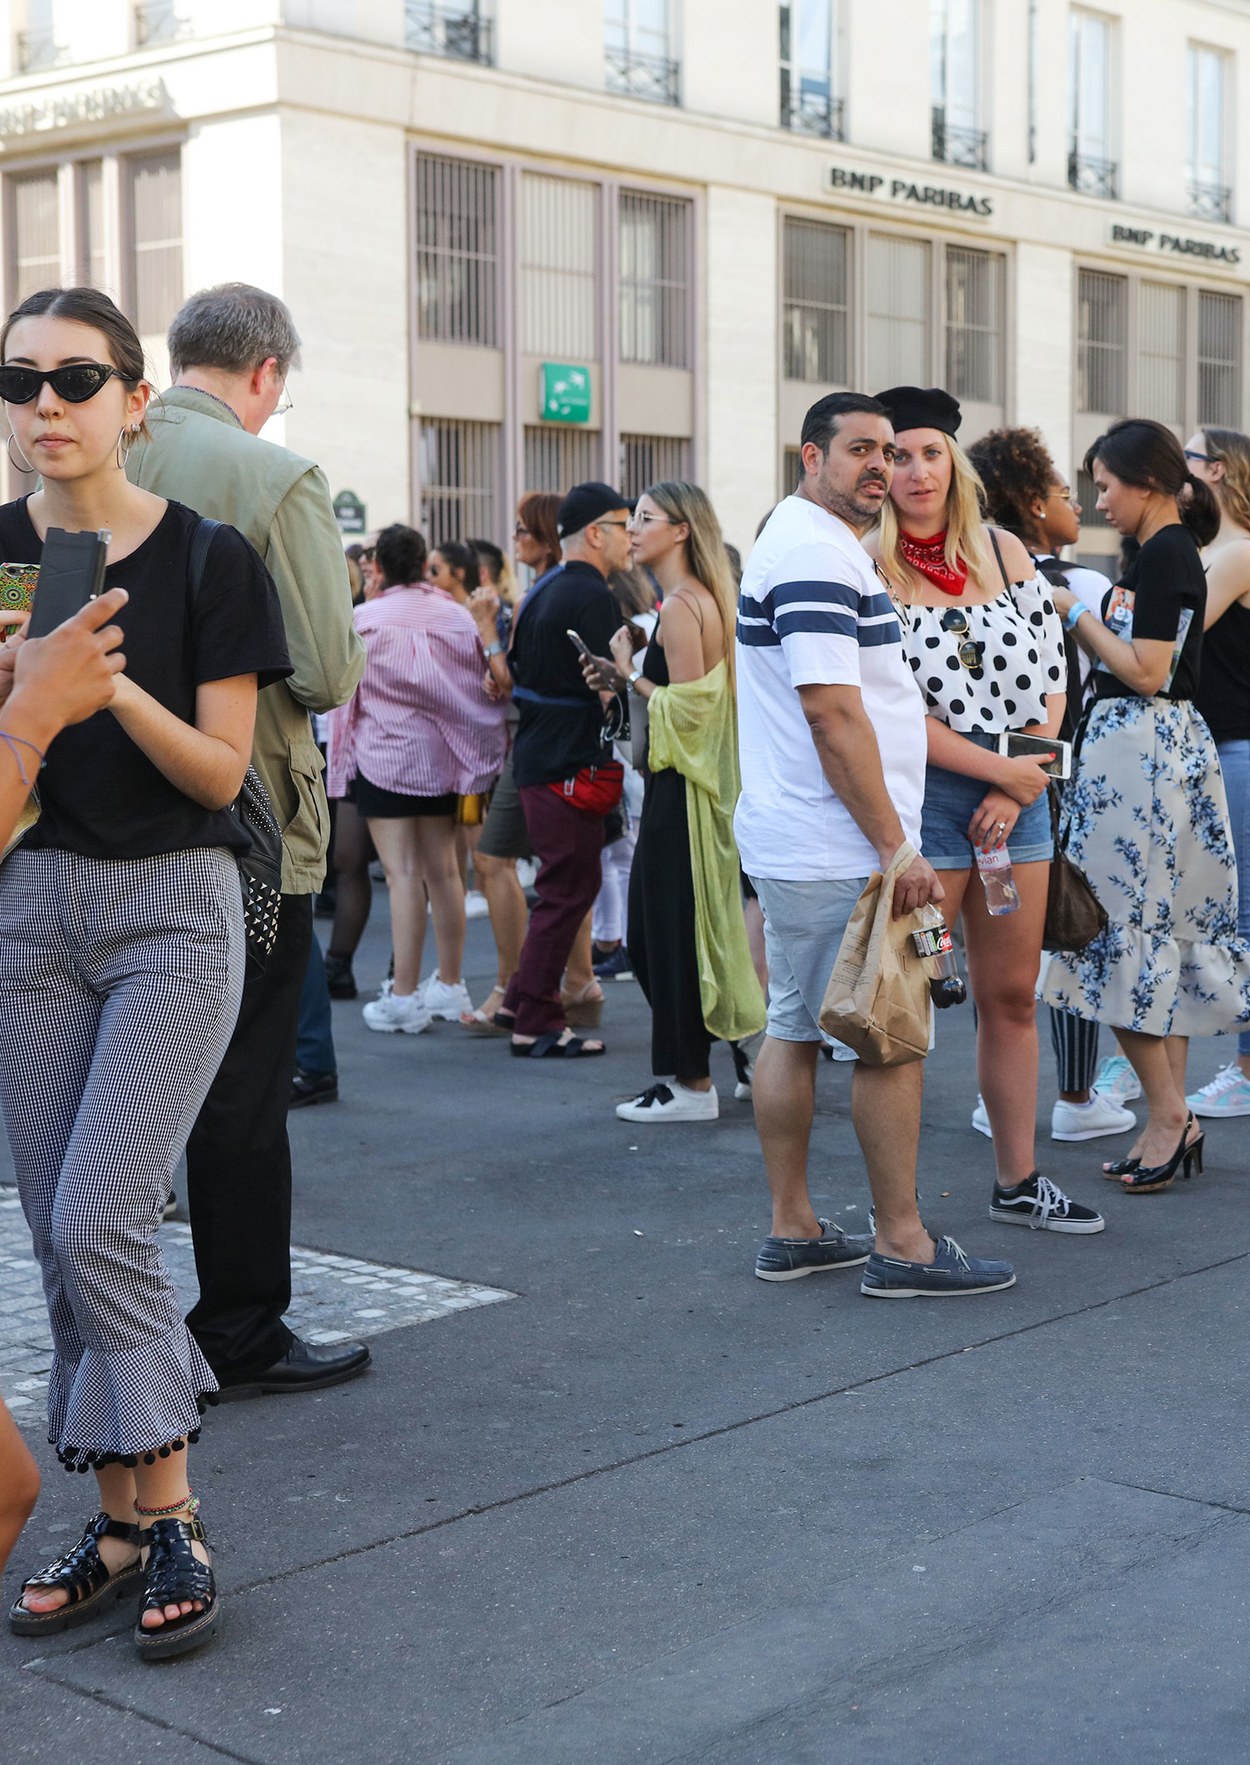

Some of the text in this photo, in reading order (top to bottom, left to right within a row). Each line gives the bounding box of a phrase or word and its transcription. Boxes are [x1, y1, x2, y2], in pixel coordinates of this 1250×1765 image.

[831, 167, 993, 216] BNP PARIBAS
[1112, 224, 1240, 264] BNP PARIBAS
